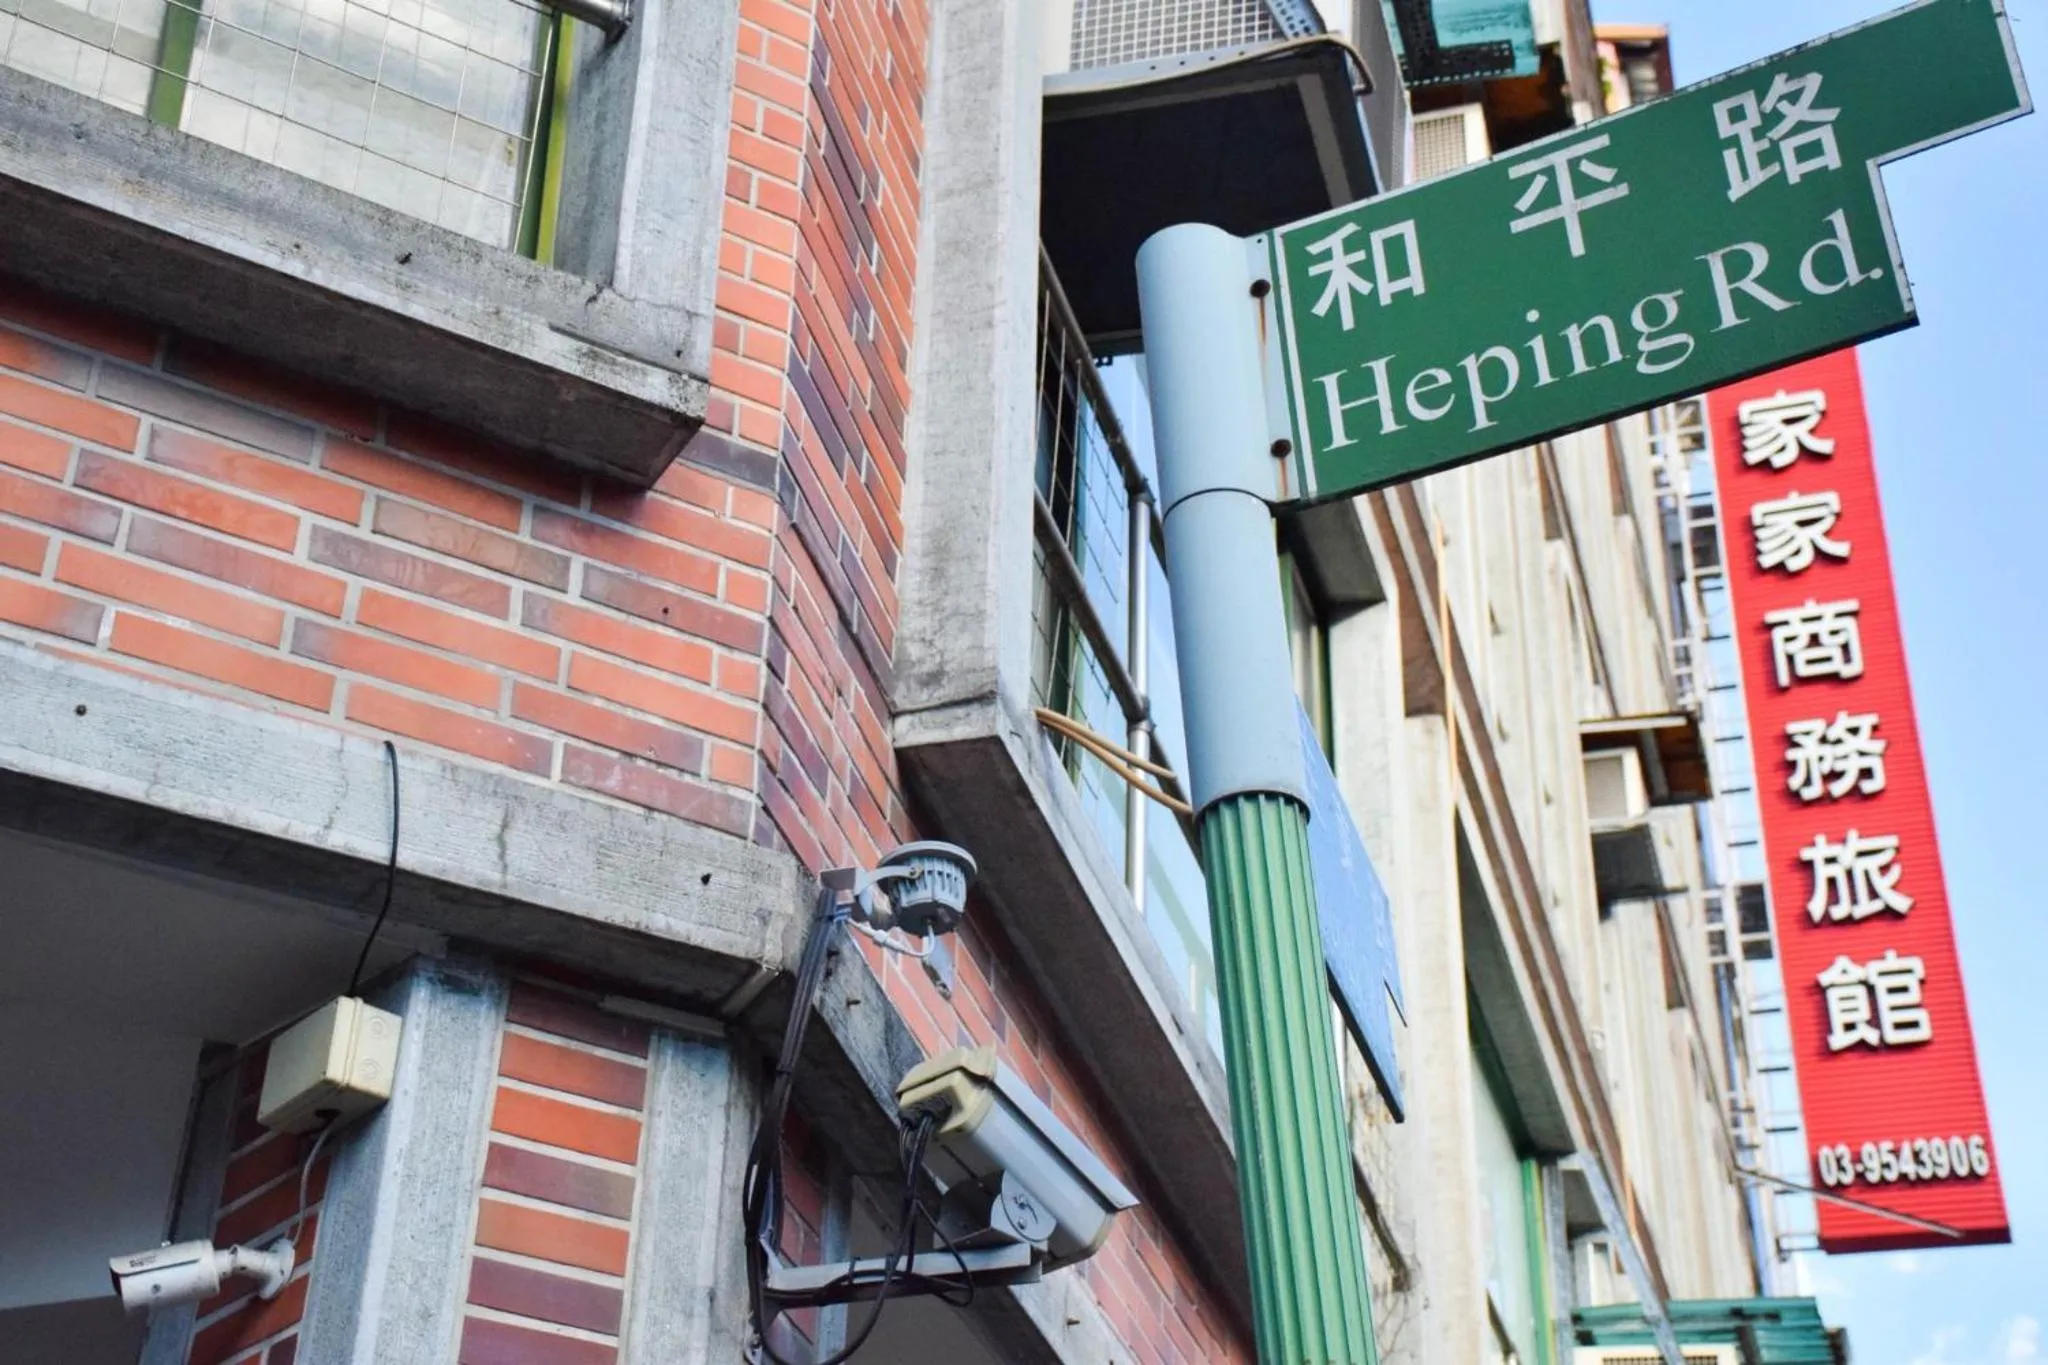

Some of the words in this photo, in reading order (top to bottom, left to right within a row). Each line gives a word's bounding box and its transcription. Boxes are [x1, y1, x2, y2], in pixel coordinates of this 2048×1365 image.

[1305, 71, 1842, 331] 和平路
[1312, 288, 1696, 452] Heping
[1694, 208, 1884, 333] Rd.
[1738, 388, 1933, 1053] 家家商務旅館
[1818, 1133, 1990, 1187] 03-9543906
